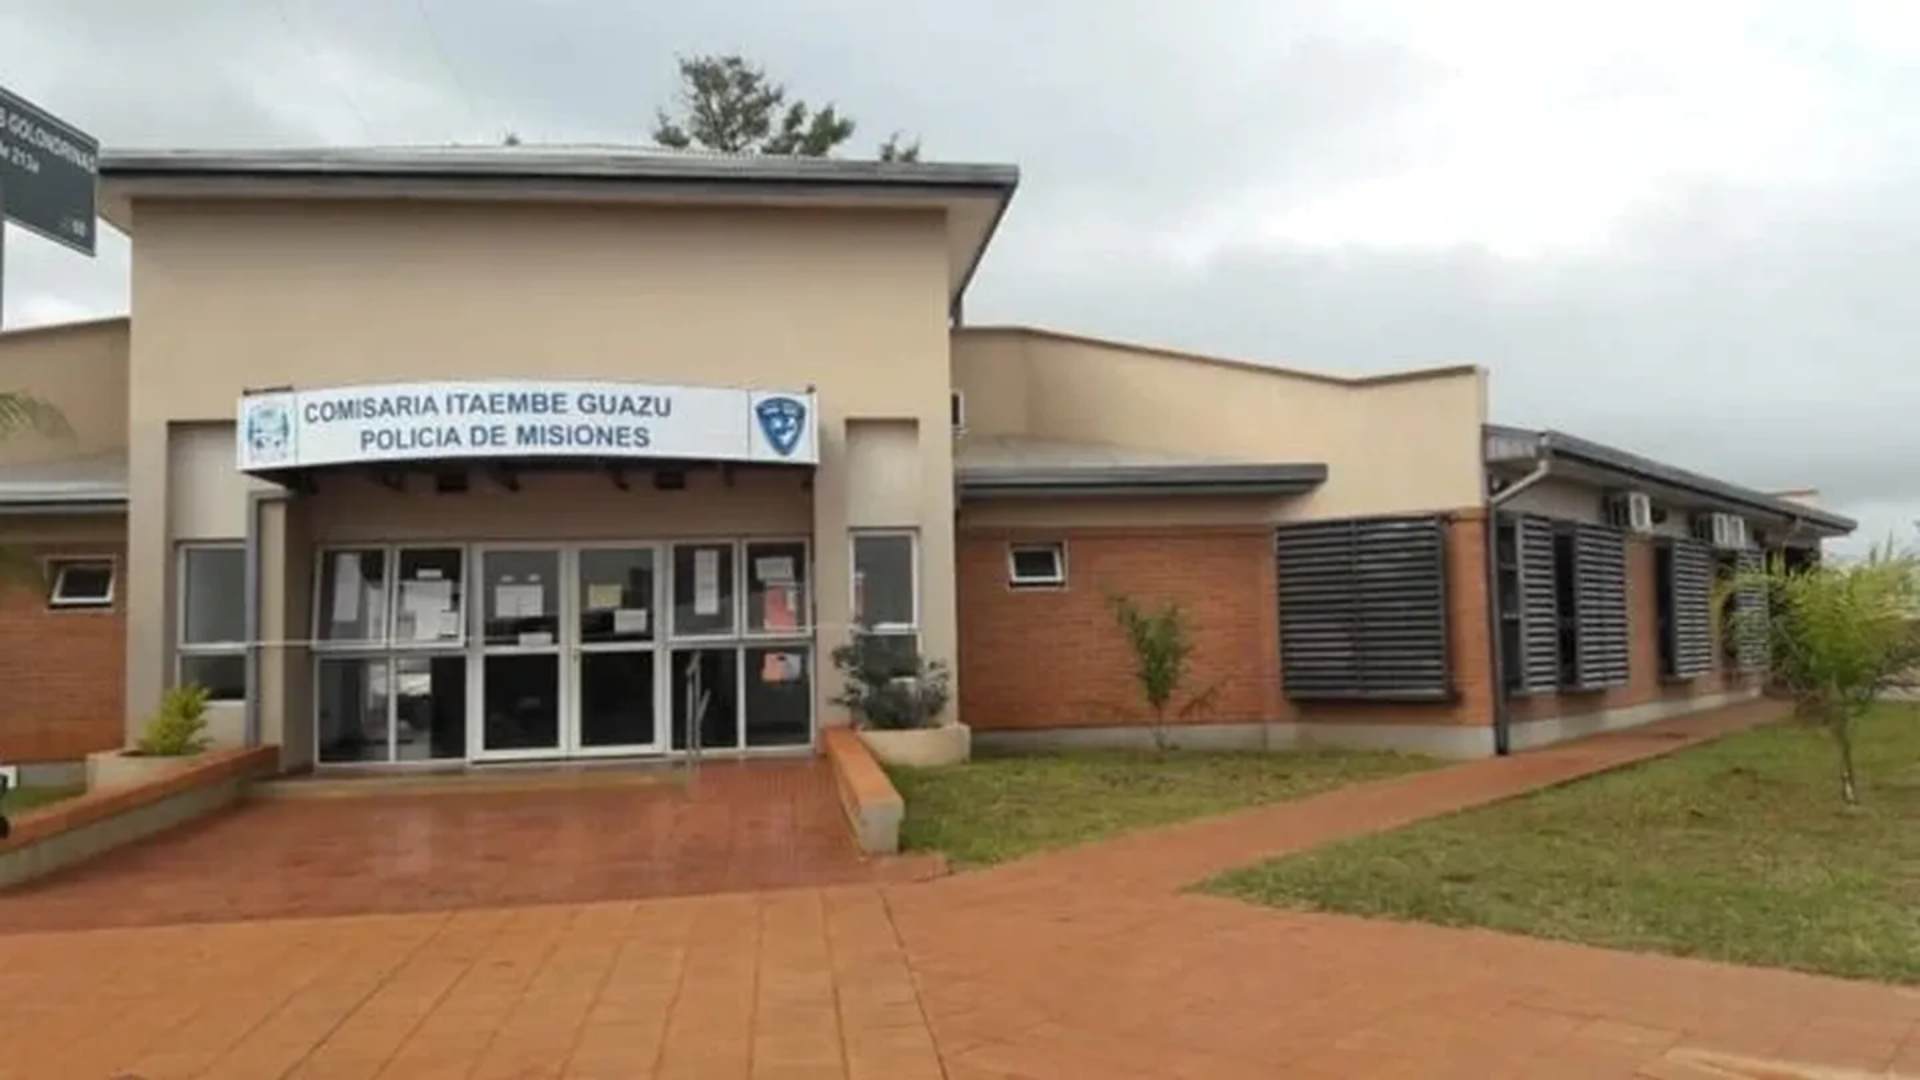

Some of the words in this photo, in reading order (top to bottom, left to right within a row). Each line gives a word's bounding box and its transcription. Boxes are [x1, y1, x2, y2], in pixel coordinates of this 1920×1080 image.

[304, 396, 438, 424] COMISARIA
[446, 393, 567, 415] ITAEMBE
[577, 393, 672, 417] GUAZU
[360, 427, 462, 452] POLICIA
[471, 426, 507, 446] DE
[516, 425, 650, 448] MISIONES
